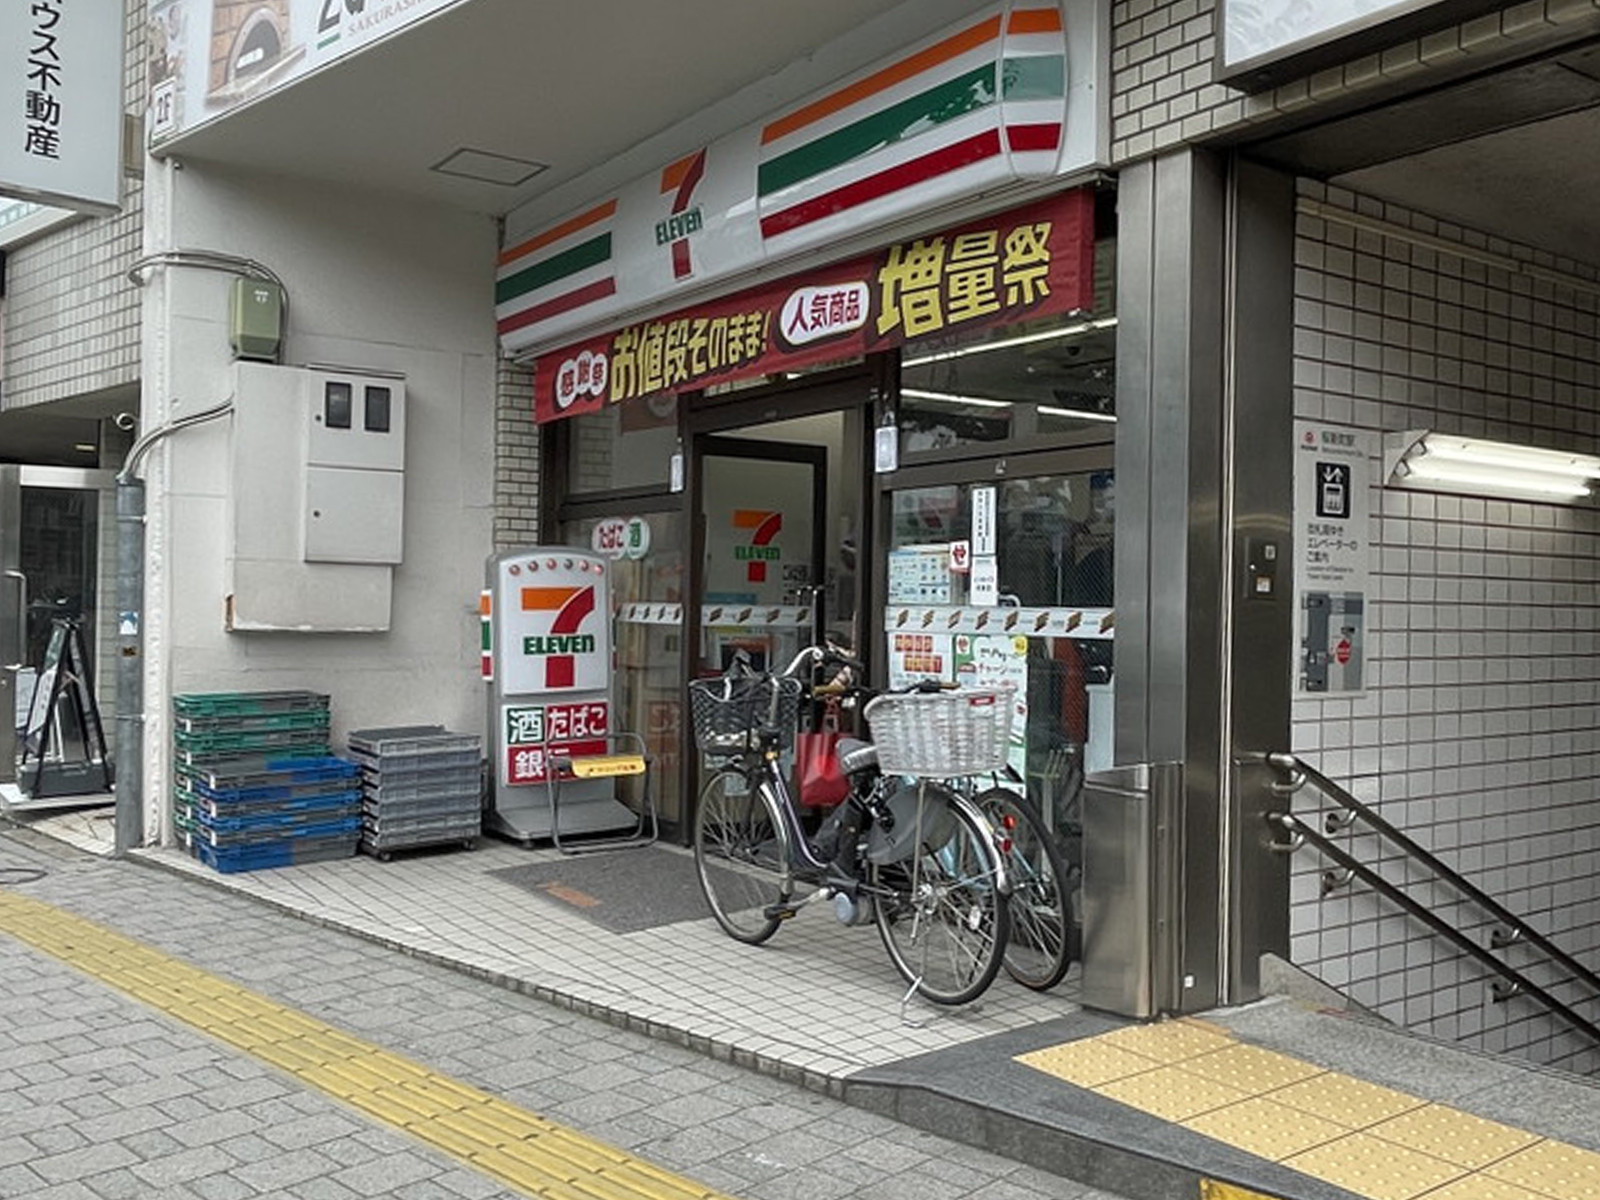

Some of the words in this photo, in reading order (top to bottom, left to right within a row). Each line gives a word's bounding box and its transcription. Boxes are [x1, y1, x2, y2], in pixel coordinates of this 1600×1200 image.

[25, 0, 62, 159] ウス不動産
[610, 310, 771, 403] お値段そのまま!
[787, 288, 860, 336] 人気商品
[876, 222, 1051, 338] 増量祭
[509, 709, 543, 743] 酒
[548, 705, 606, 740] たばこ
